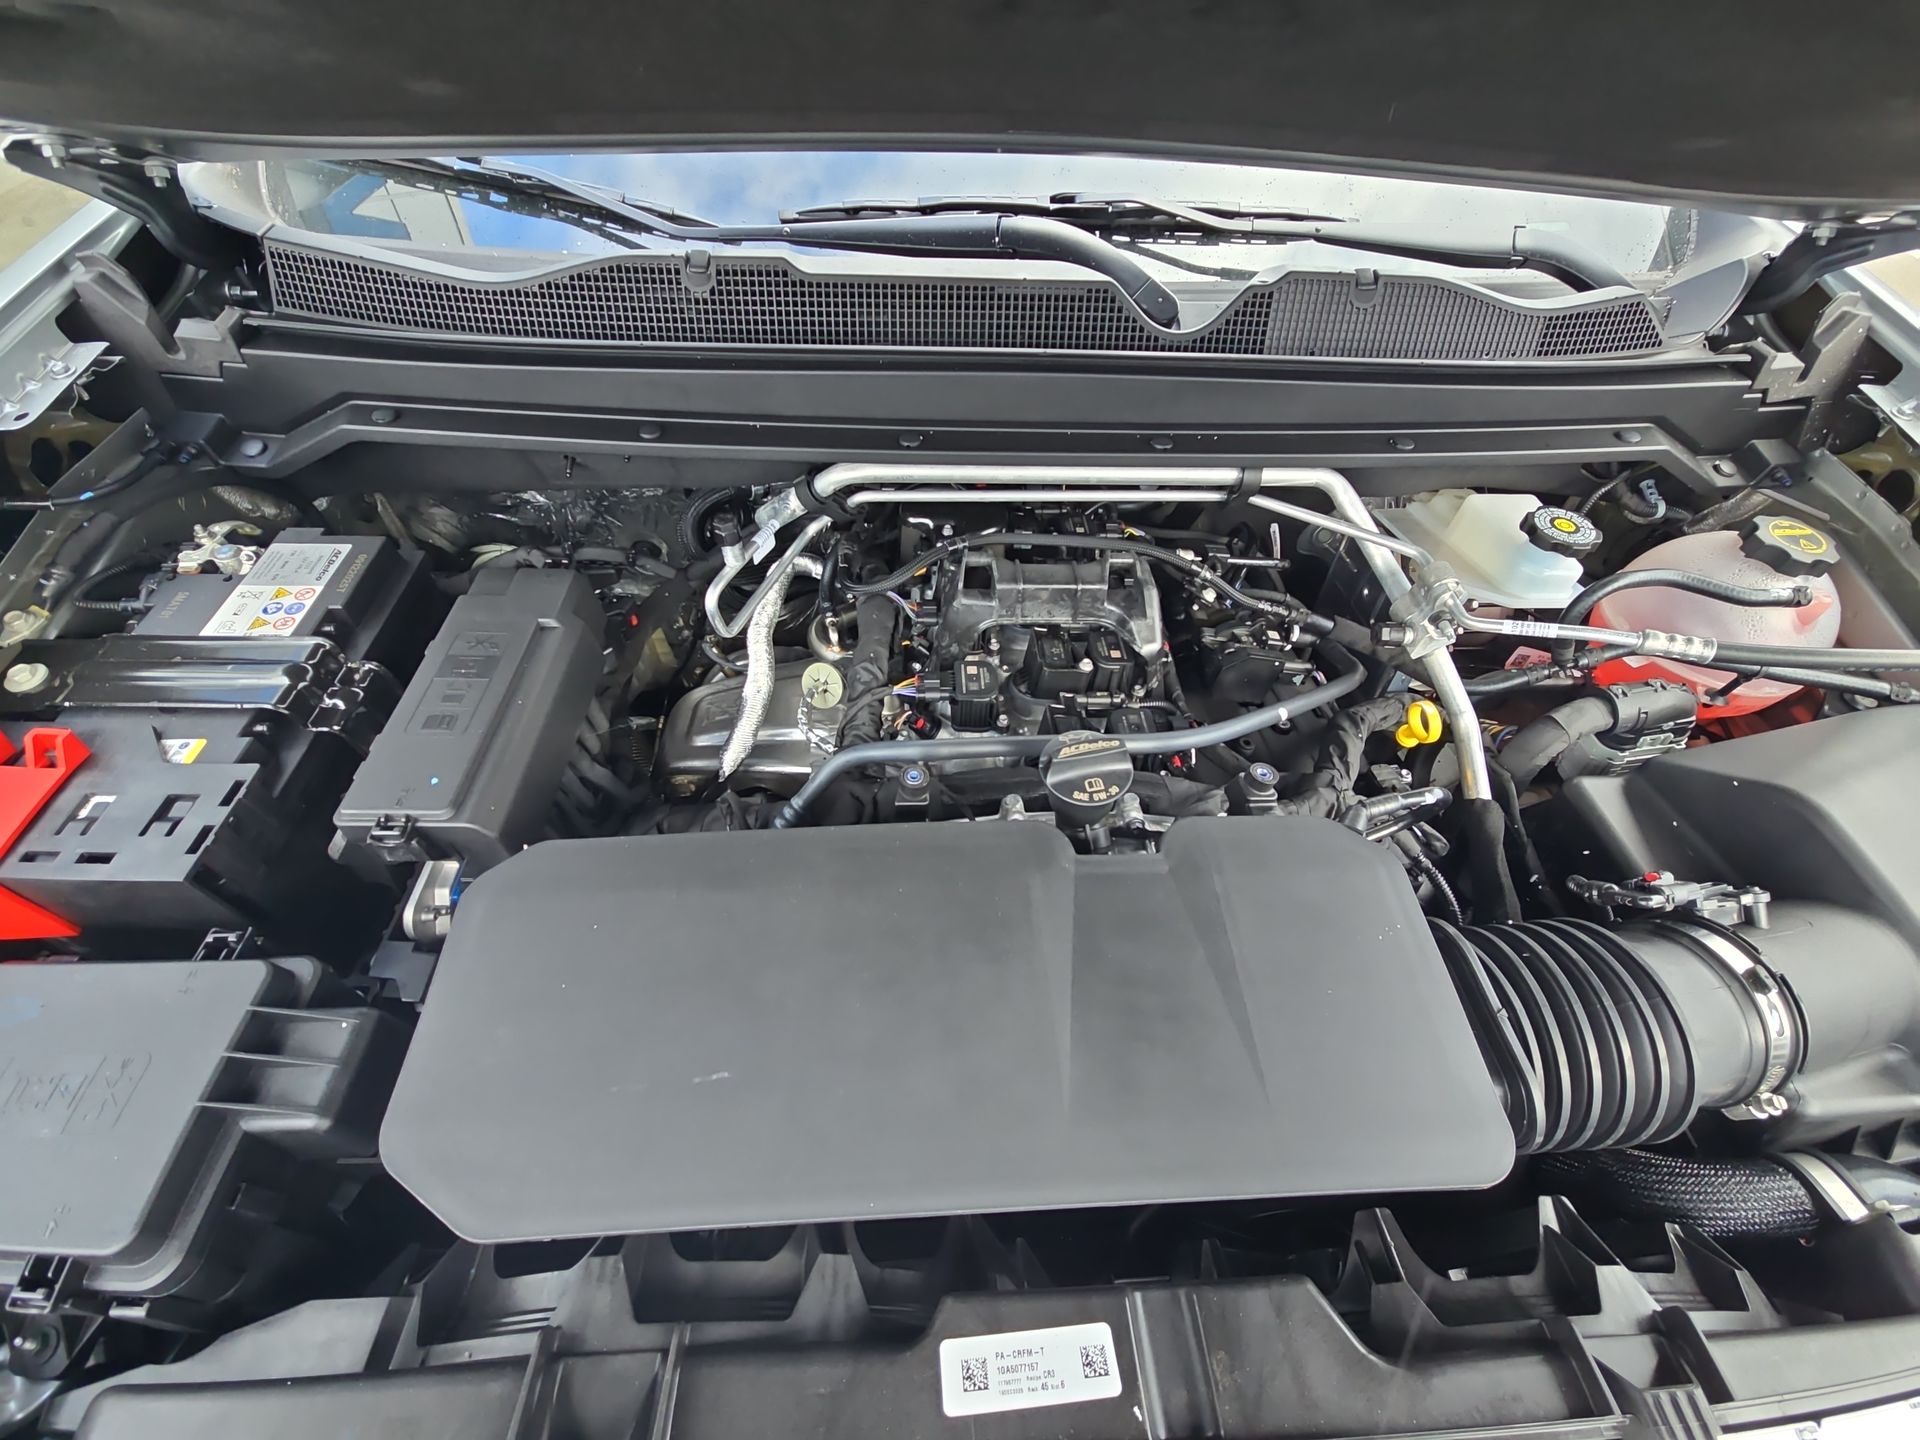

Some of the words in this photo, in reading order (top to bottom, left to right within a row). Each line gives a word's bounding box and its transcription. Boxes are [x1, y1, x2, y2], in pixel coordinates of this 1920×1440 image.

[315, 547, 342, 582] ACDelco
[1057, 740, 1121, 758] ACDelco
[1072, 790, 1090, 801] SAE
[995, 1347, 1044, 1360] PA-CRFM-T
[1042, 1369, 1056, 1380] CR3
[1041, 1381, 1049, 1391] 45
